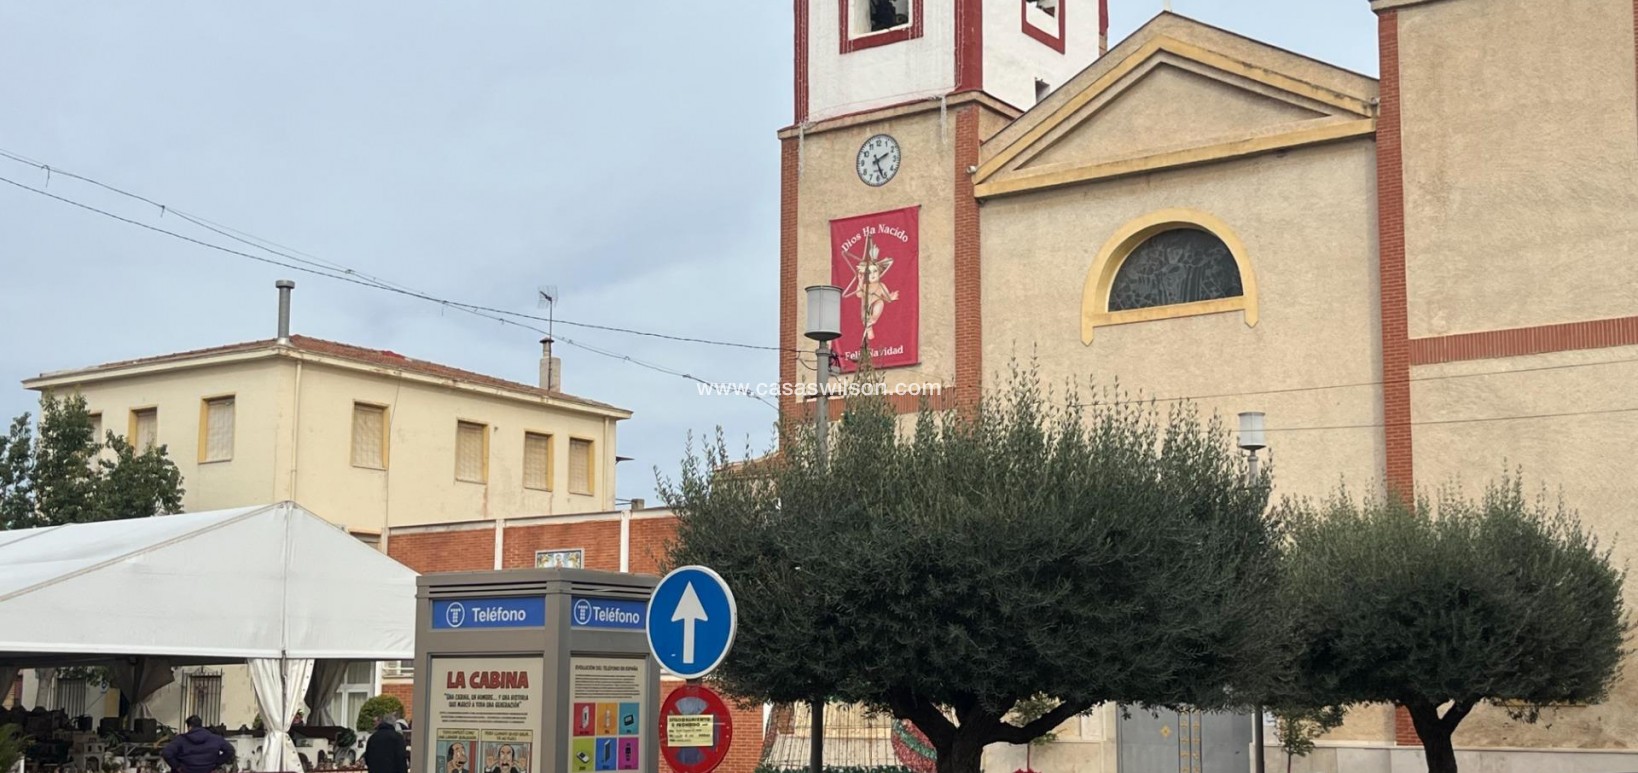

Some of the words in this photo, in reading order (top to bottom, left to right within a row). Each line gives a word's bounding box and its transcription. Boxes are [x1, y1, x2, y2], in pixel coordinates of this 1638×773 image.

[841, 233, 862, 252] Dios
[862, 226, 876, 237] Ha
[878, 223, 909, 243] Nacido
[844, 350, 863, 361] Feli
[472, 607, 526, 622] Teléfono
[592, 606, 640, 624] Teléfono
[447, 671, 466, 689] LA
[469, 671, 529, 689] CABINA
